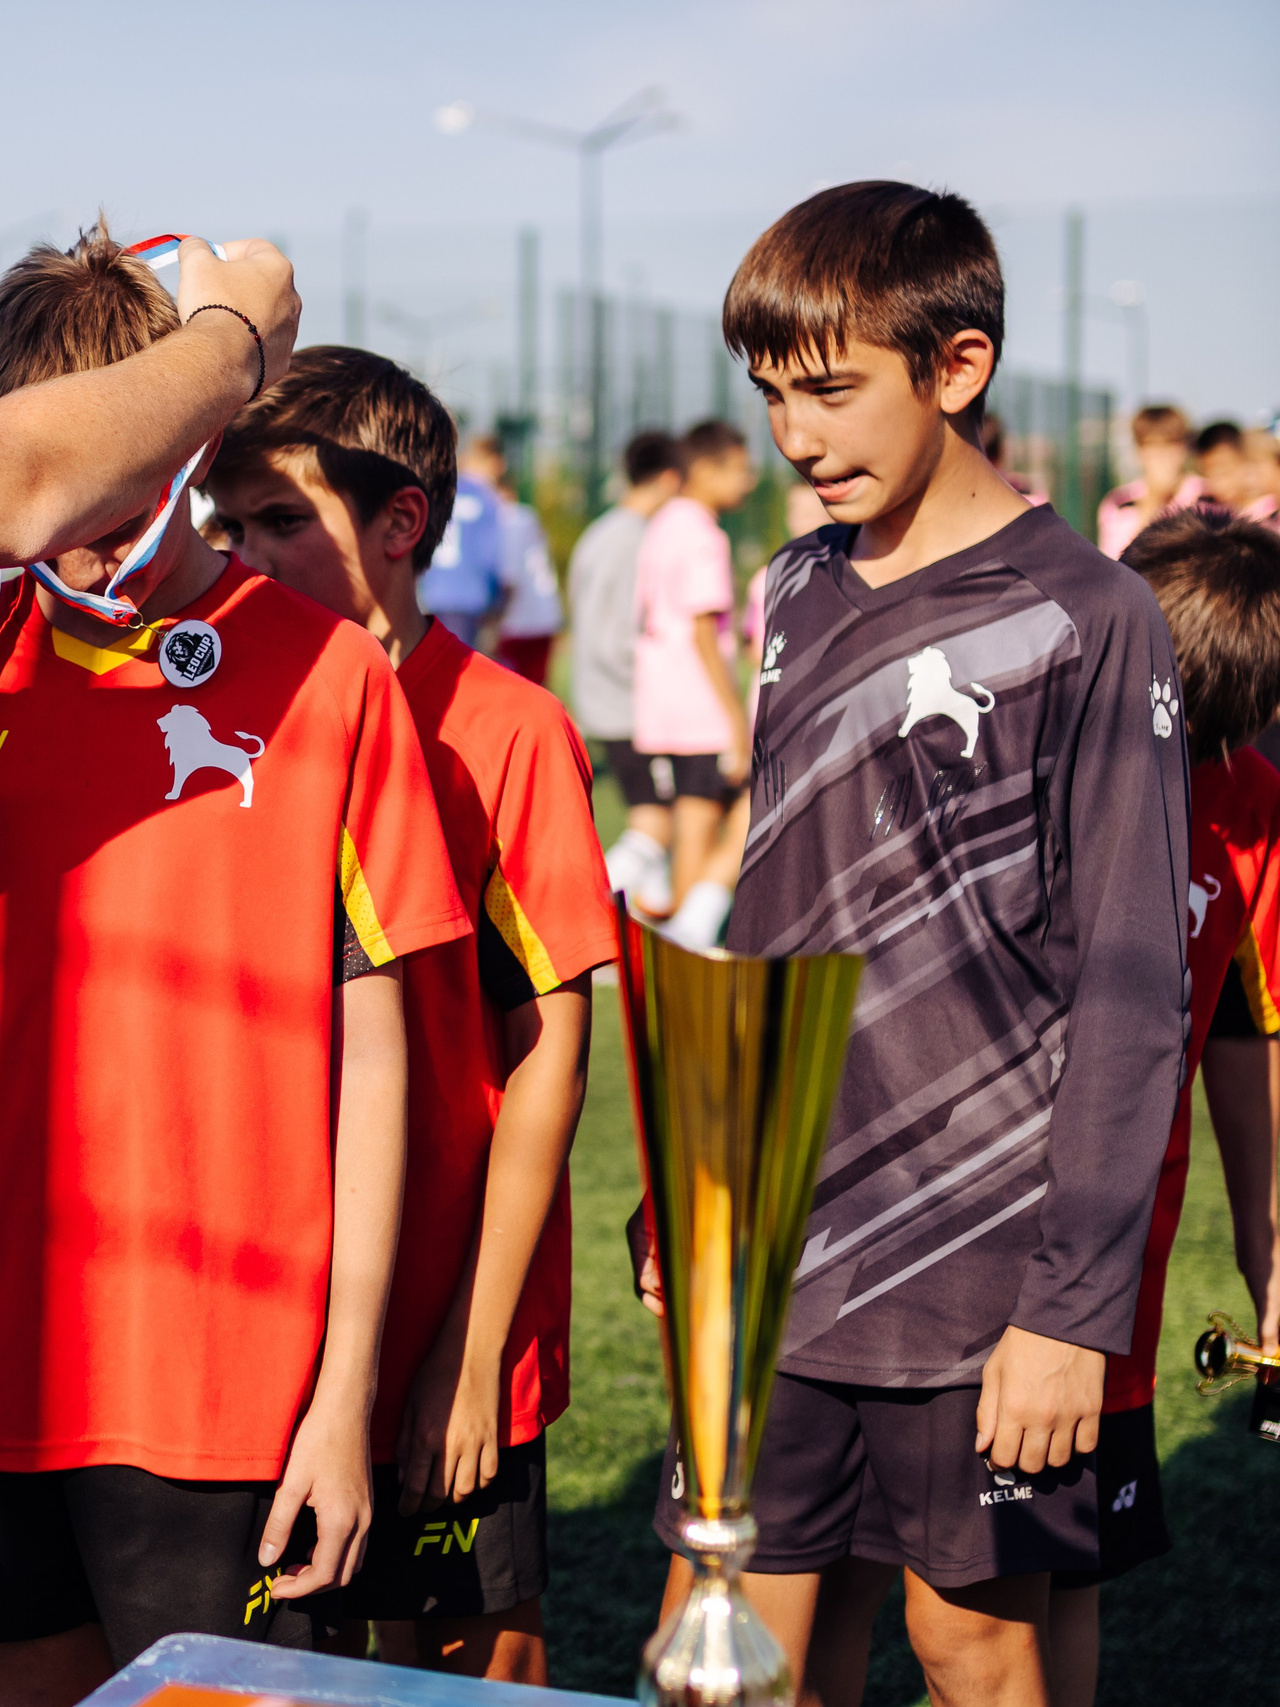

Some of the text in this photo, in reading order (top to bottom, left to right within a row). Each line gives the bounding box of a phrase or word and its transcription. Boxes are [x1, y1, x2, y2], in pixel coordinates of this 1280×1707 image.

[183, 657, 201, 680] LEO
[194, 635, 212, 660] CUP
[979, 1486, 1034, 1507] KELME
[413, 1517, 480, 1556] FN
